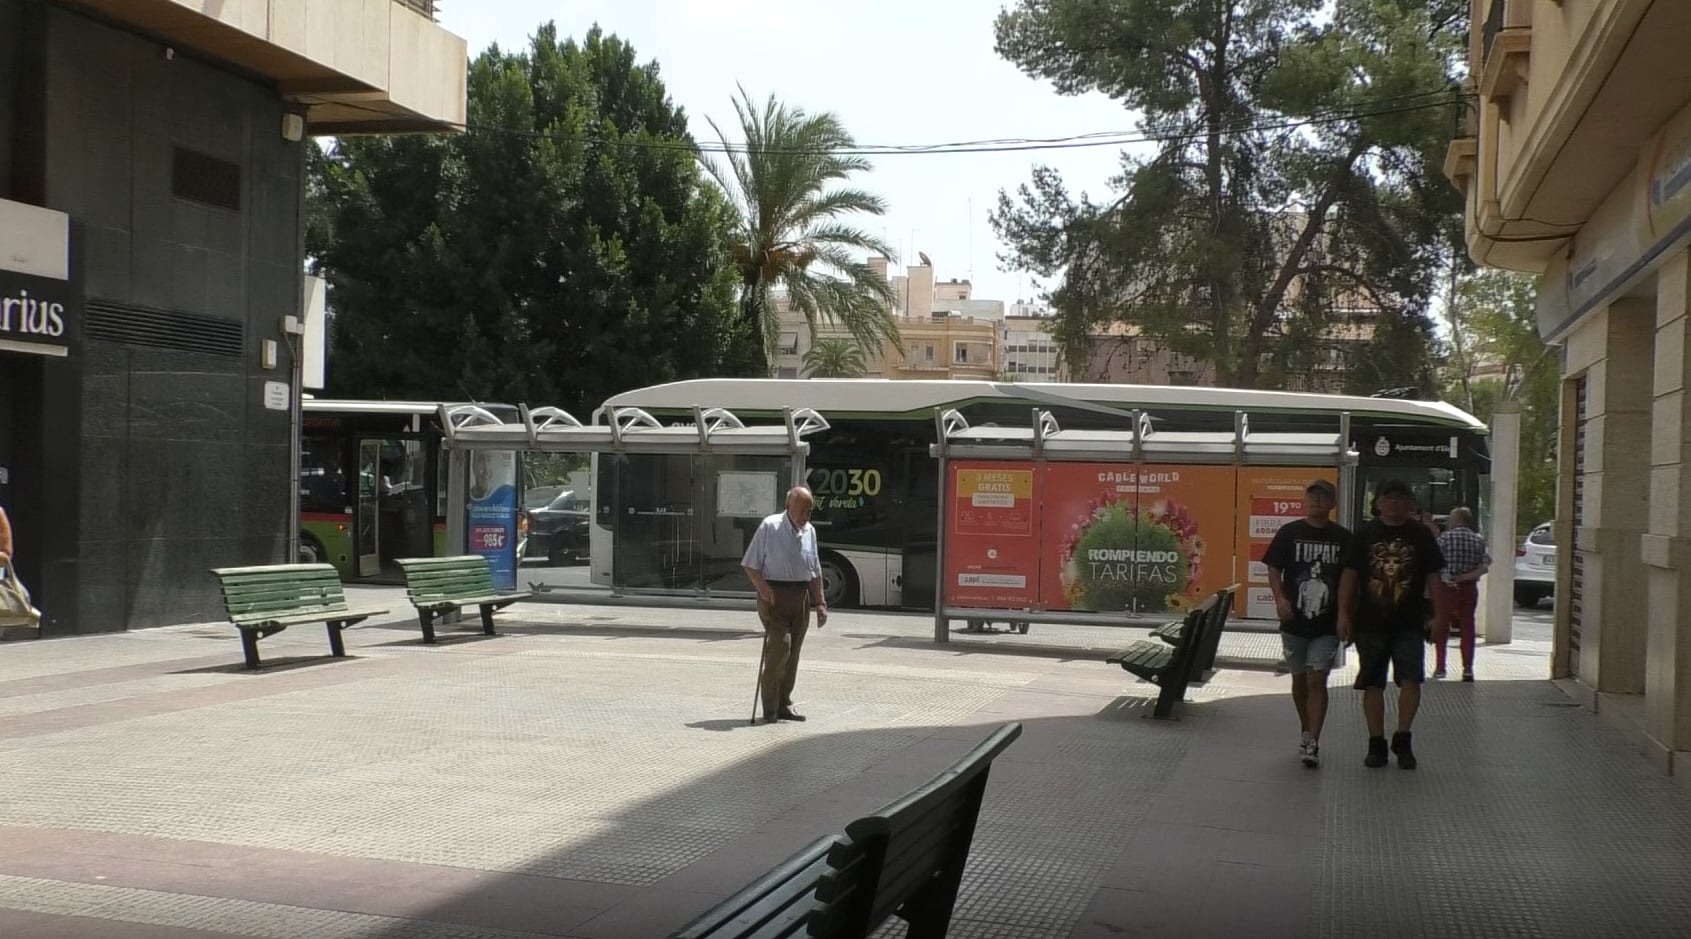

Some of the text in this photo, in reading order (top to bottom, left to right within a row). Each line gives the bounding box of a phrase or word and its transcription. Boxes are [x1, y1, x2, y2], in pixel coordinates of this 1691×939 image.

[0, 289, 64, 336] rius
[978, 483, 1011, 492] GRATIS
[1256, 519, 1282, 527] FIBRA
[1088, 549, 1178, 562] ROMPIENDO
[1088, 562, 1177, 583] TARIFAS
